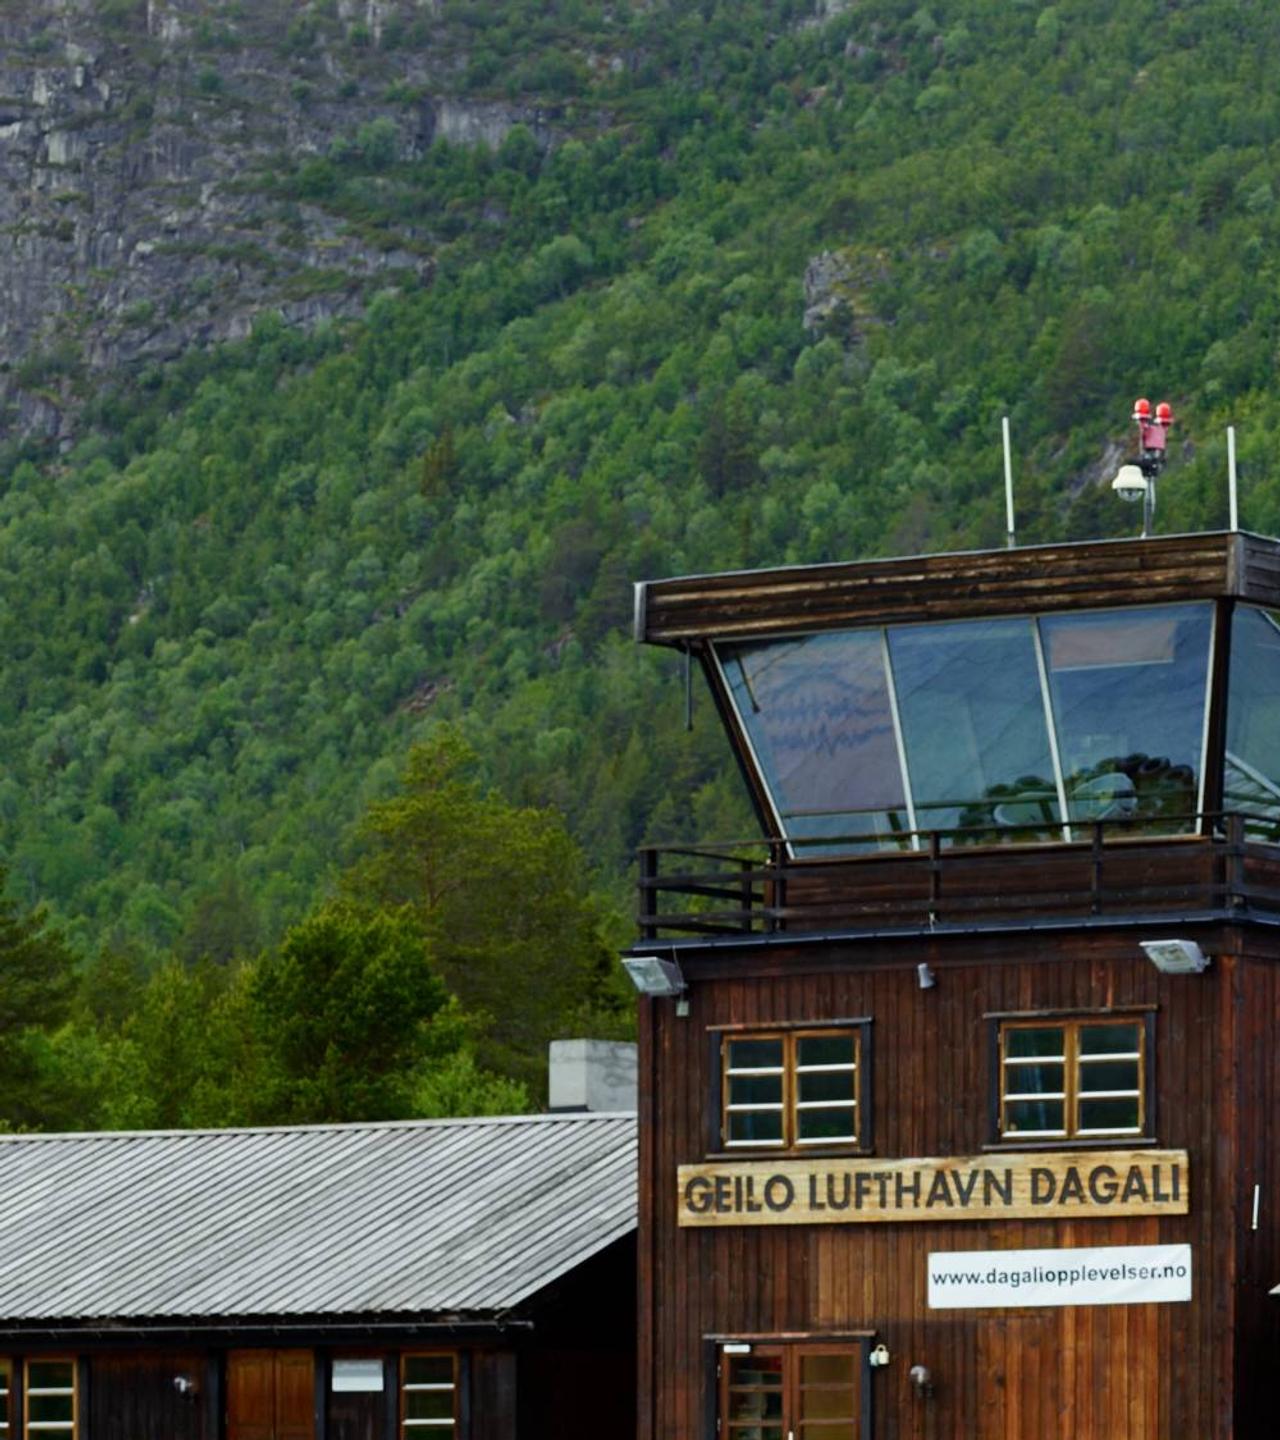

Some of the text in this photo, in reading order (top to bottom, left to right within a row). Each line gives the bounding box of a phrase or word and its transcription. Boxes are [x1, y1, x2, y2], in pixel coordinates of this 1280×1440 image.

[684, 1164, 1181, 1213] GEILO LUFTHAVN DAGALI
[932, 1264, 1188, 1288] www.dagaliopplevelser.no
